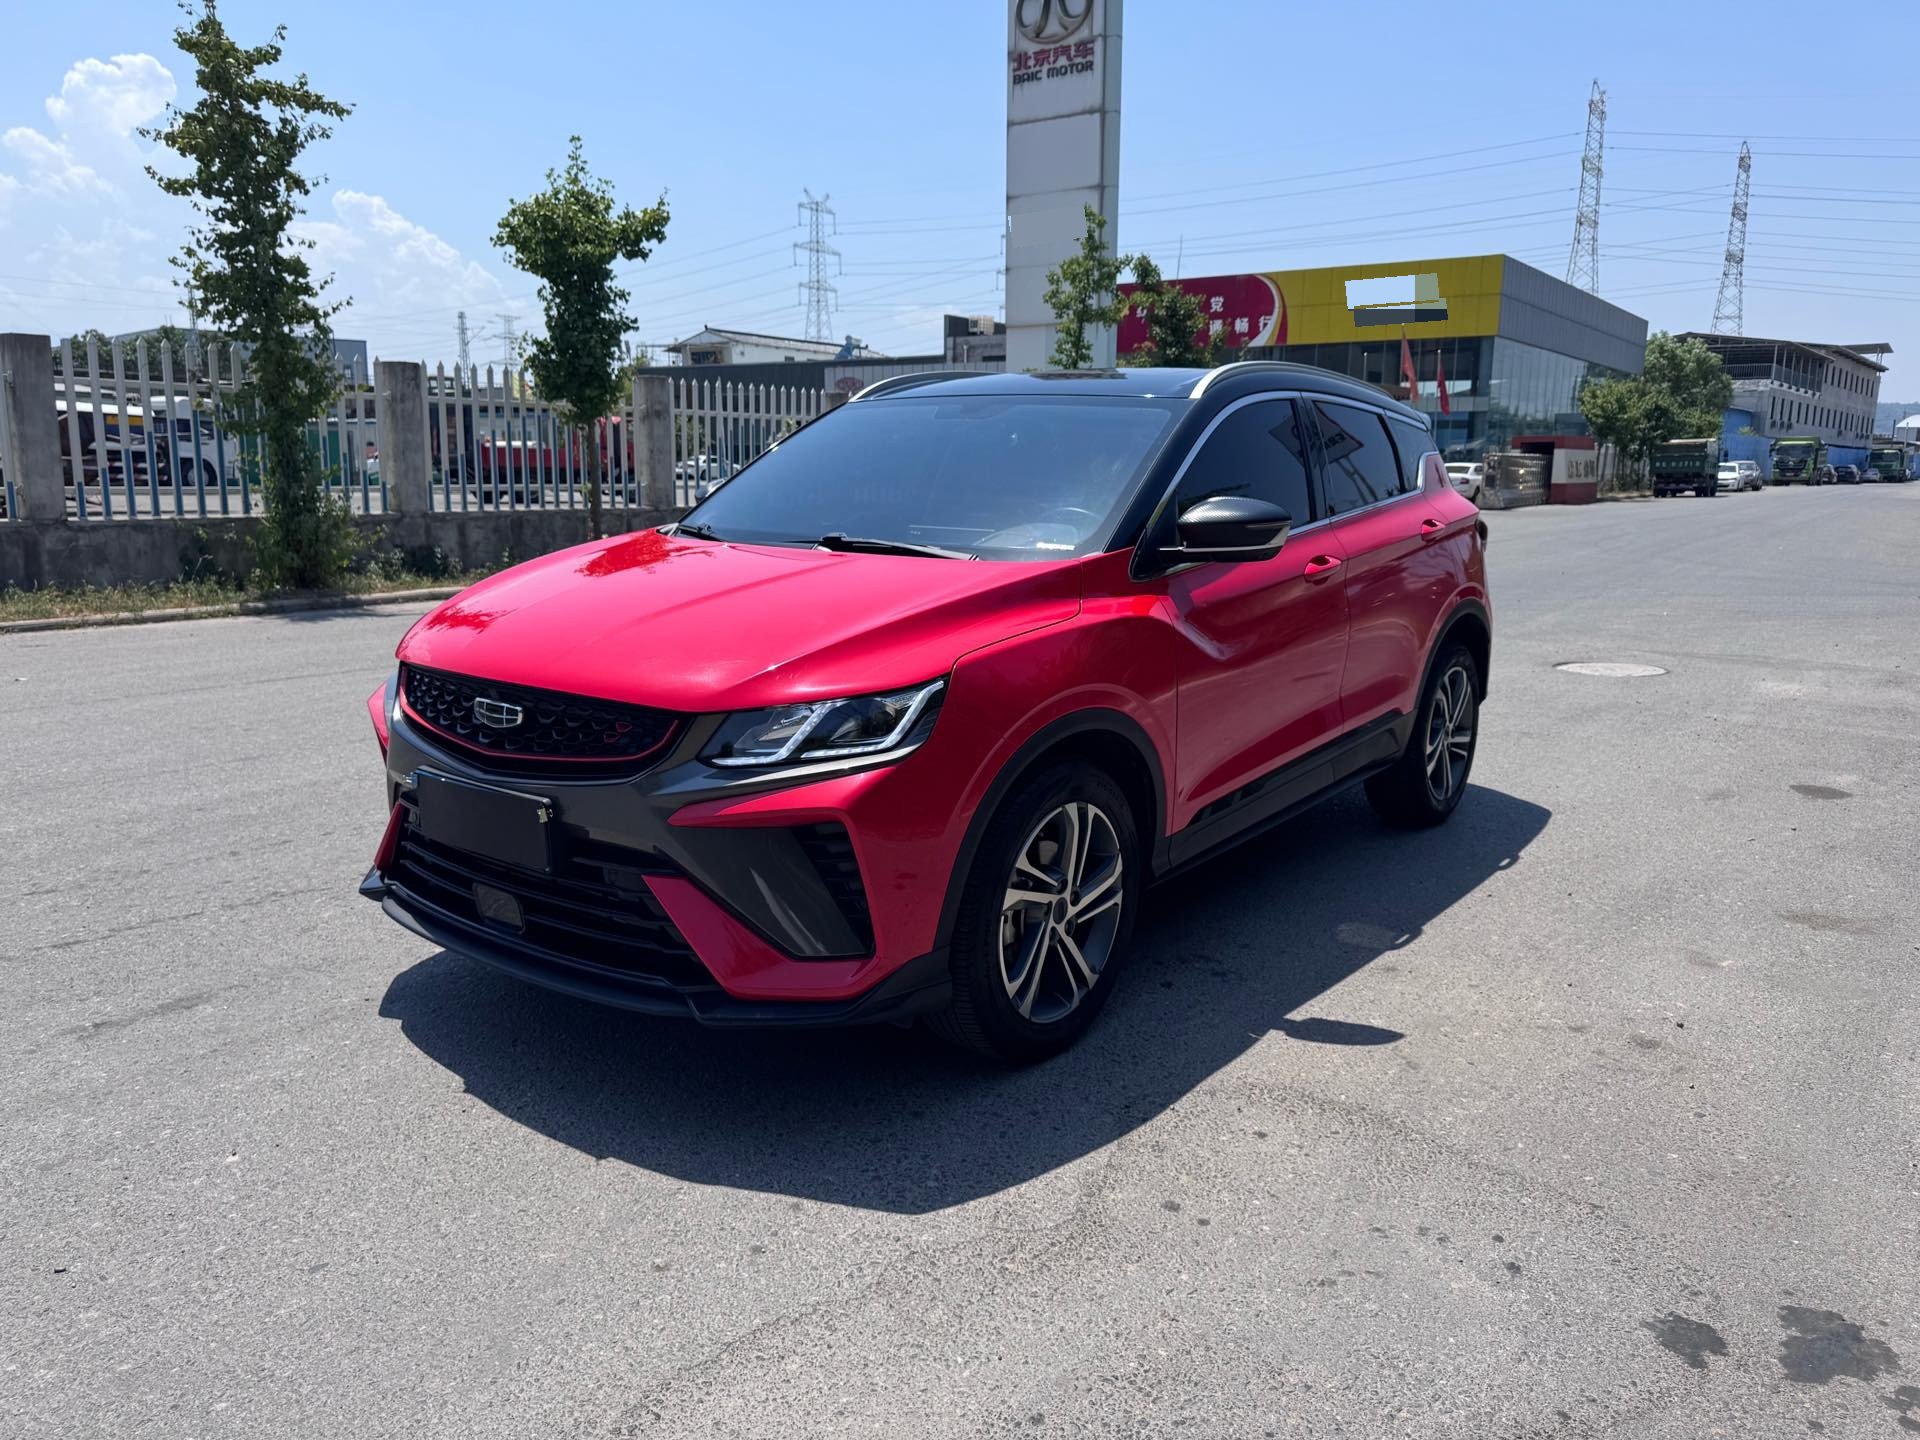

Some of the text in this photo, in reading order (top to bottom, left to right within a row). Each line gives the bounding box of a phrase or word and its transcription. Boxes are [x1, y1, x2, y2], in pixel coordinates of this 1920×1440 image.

[1013, 41, 1094, 72] 北京汽车
[1013, 61, 1093, 85] BAIC MOTOR
